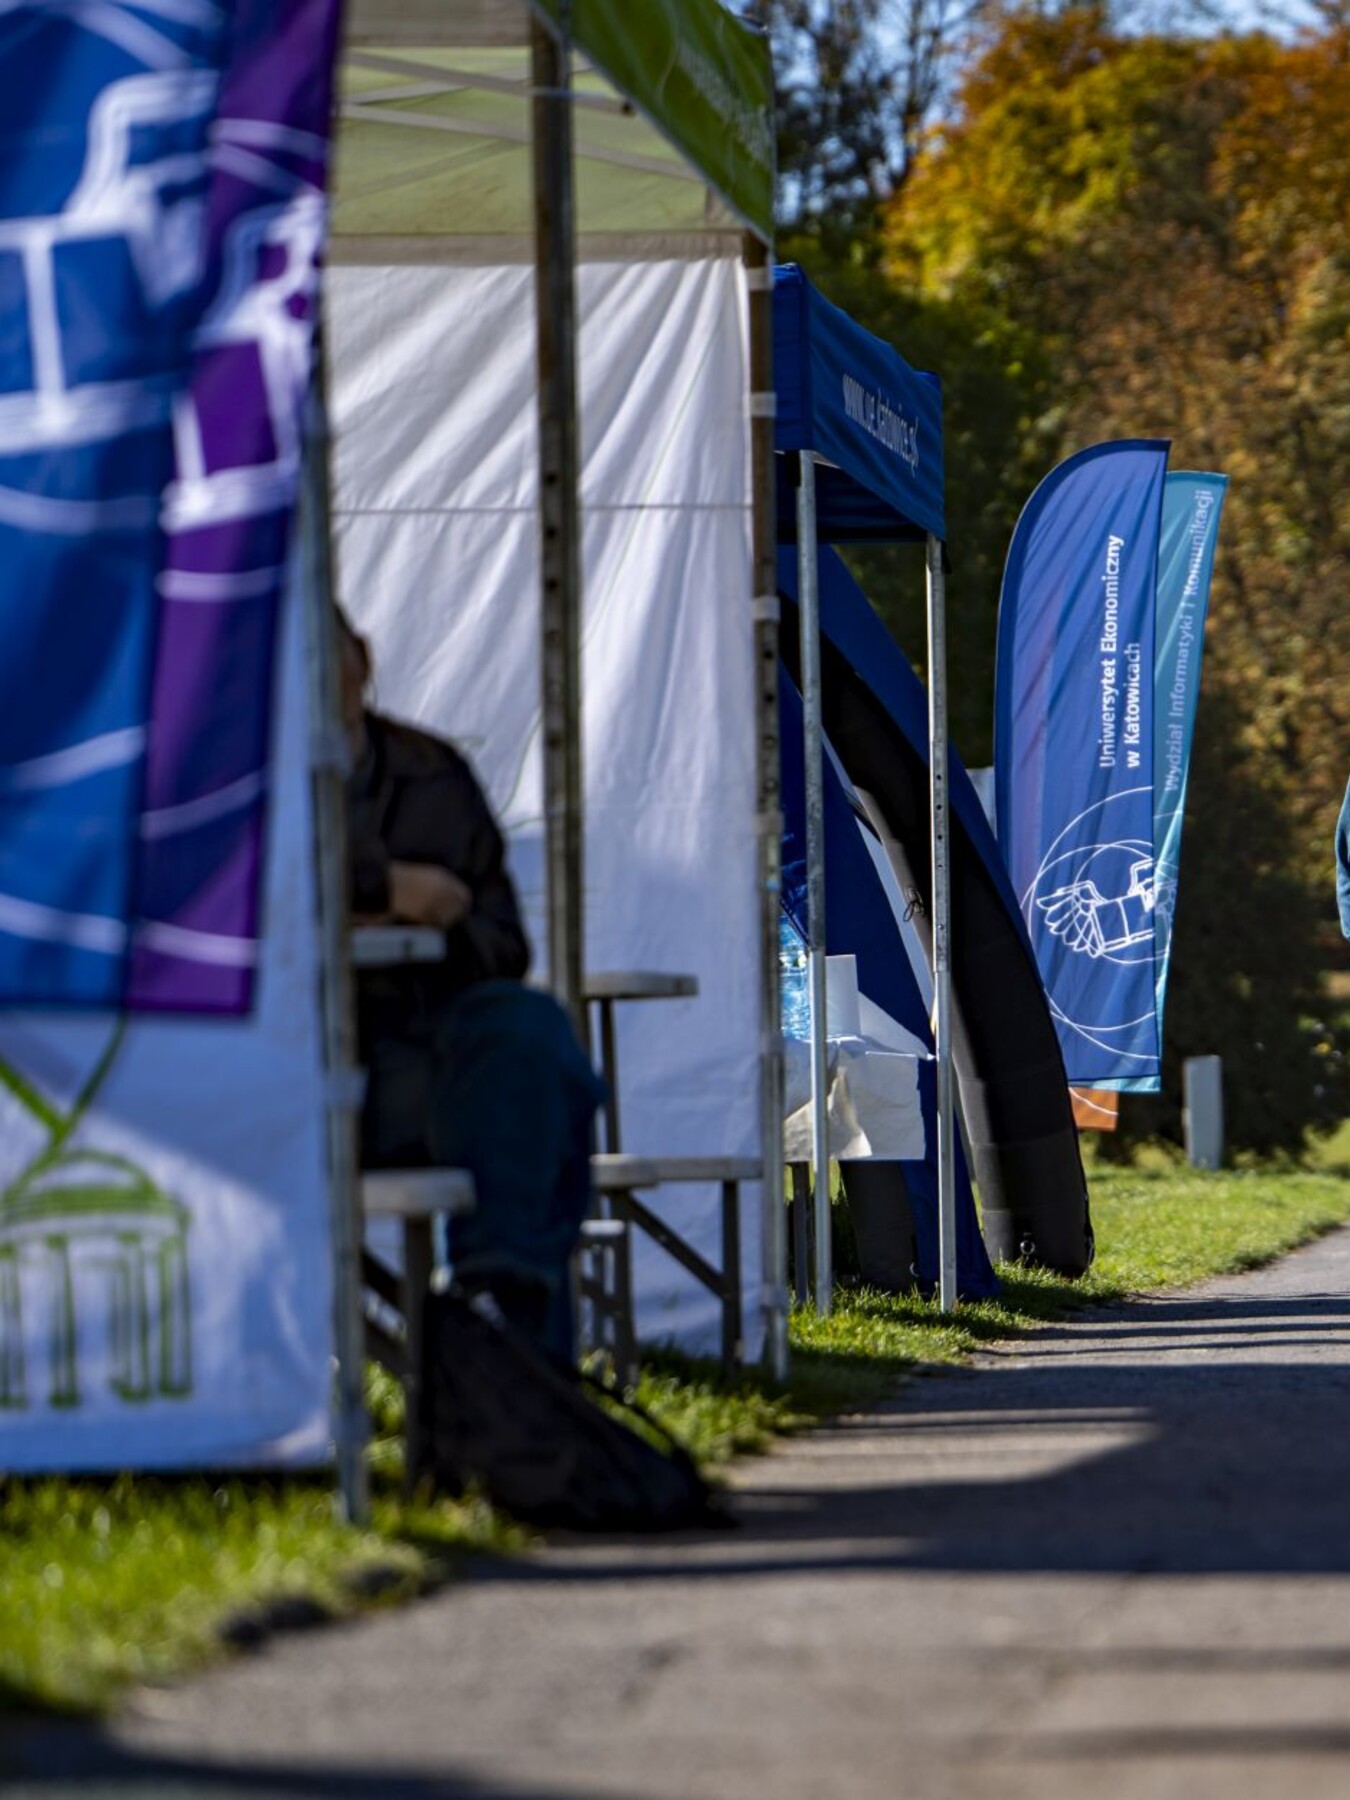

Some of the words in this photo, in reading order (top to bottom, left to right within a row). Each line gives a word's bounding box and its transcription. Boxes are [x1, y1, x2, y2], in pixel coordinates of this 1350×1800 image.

[1100, 535, 1123, 652] Ekonomiczny
[1183, 490, 1213, 596] Komunikacji
[1098, 659, 1119, 768] Uniwersytet
[1124, 643, 1141, 744] Katowicach
[1169, 615, 1194, 717] Informatyki
[1127, 751, 1140, 768] w
[1164, 724, 1183, 792] Wydział
